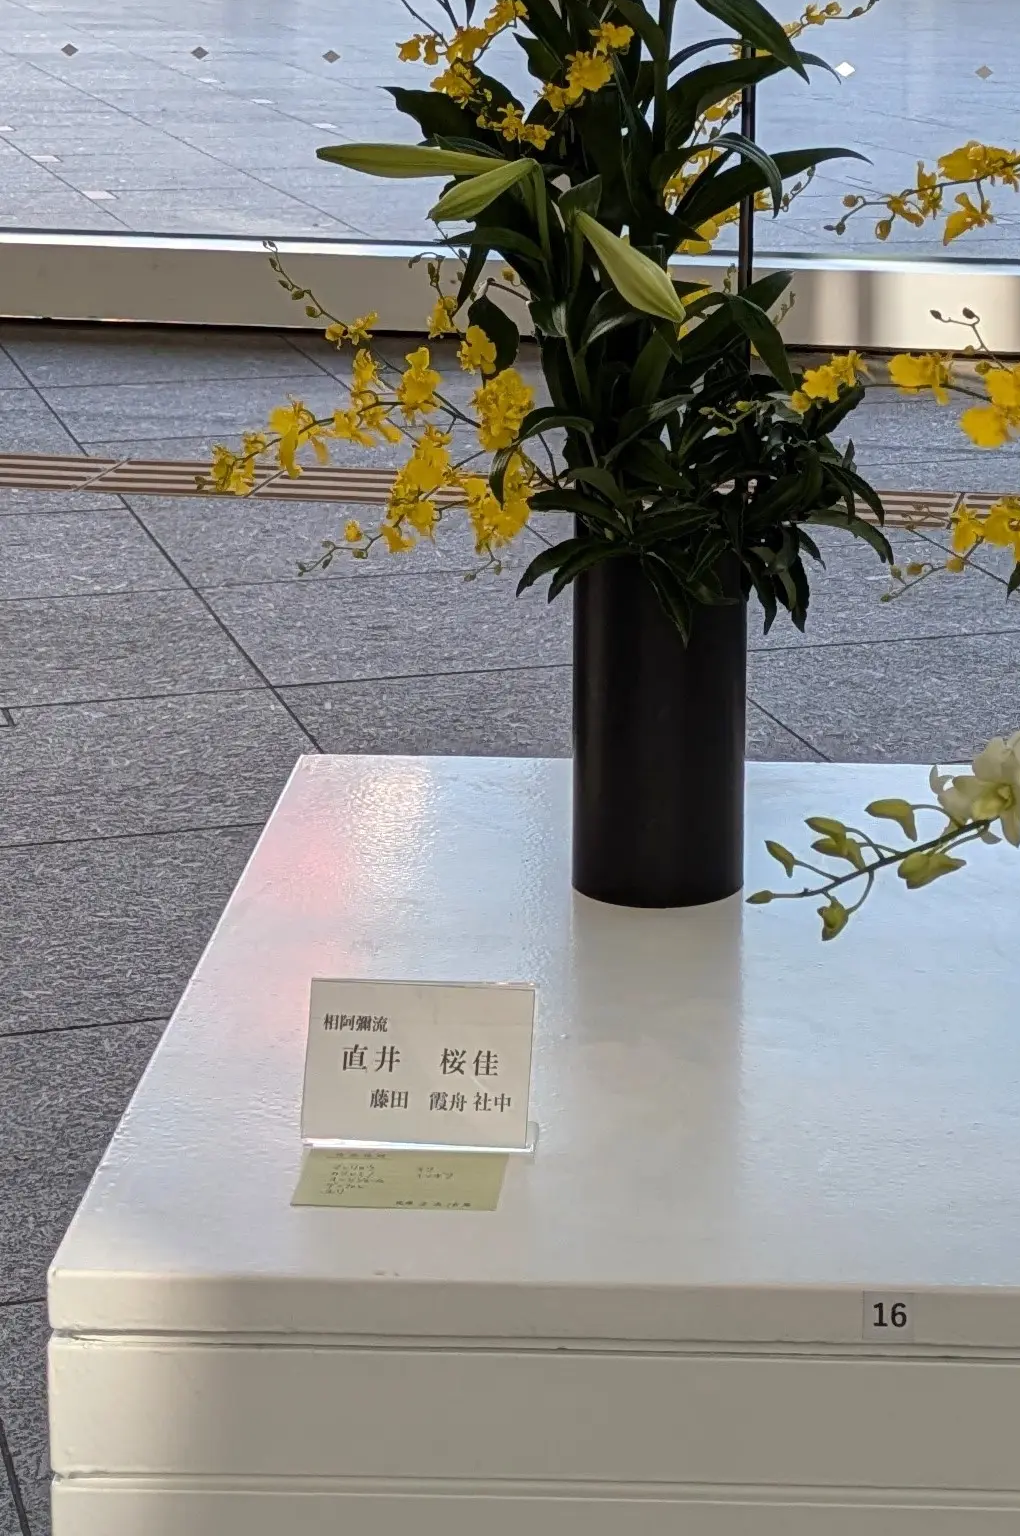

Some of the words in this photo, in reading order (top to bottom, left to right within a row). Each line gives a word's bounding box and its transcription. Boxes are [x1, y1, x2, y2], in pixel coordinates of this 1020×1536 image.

[342, 1044, 400, 1072] 直井
[440, 1048, 499, 1076] 桜佳
[370, 1088, 409, 1109] 藤田
[873, 1302, 907, 1328] 16
